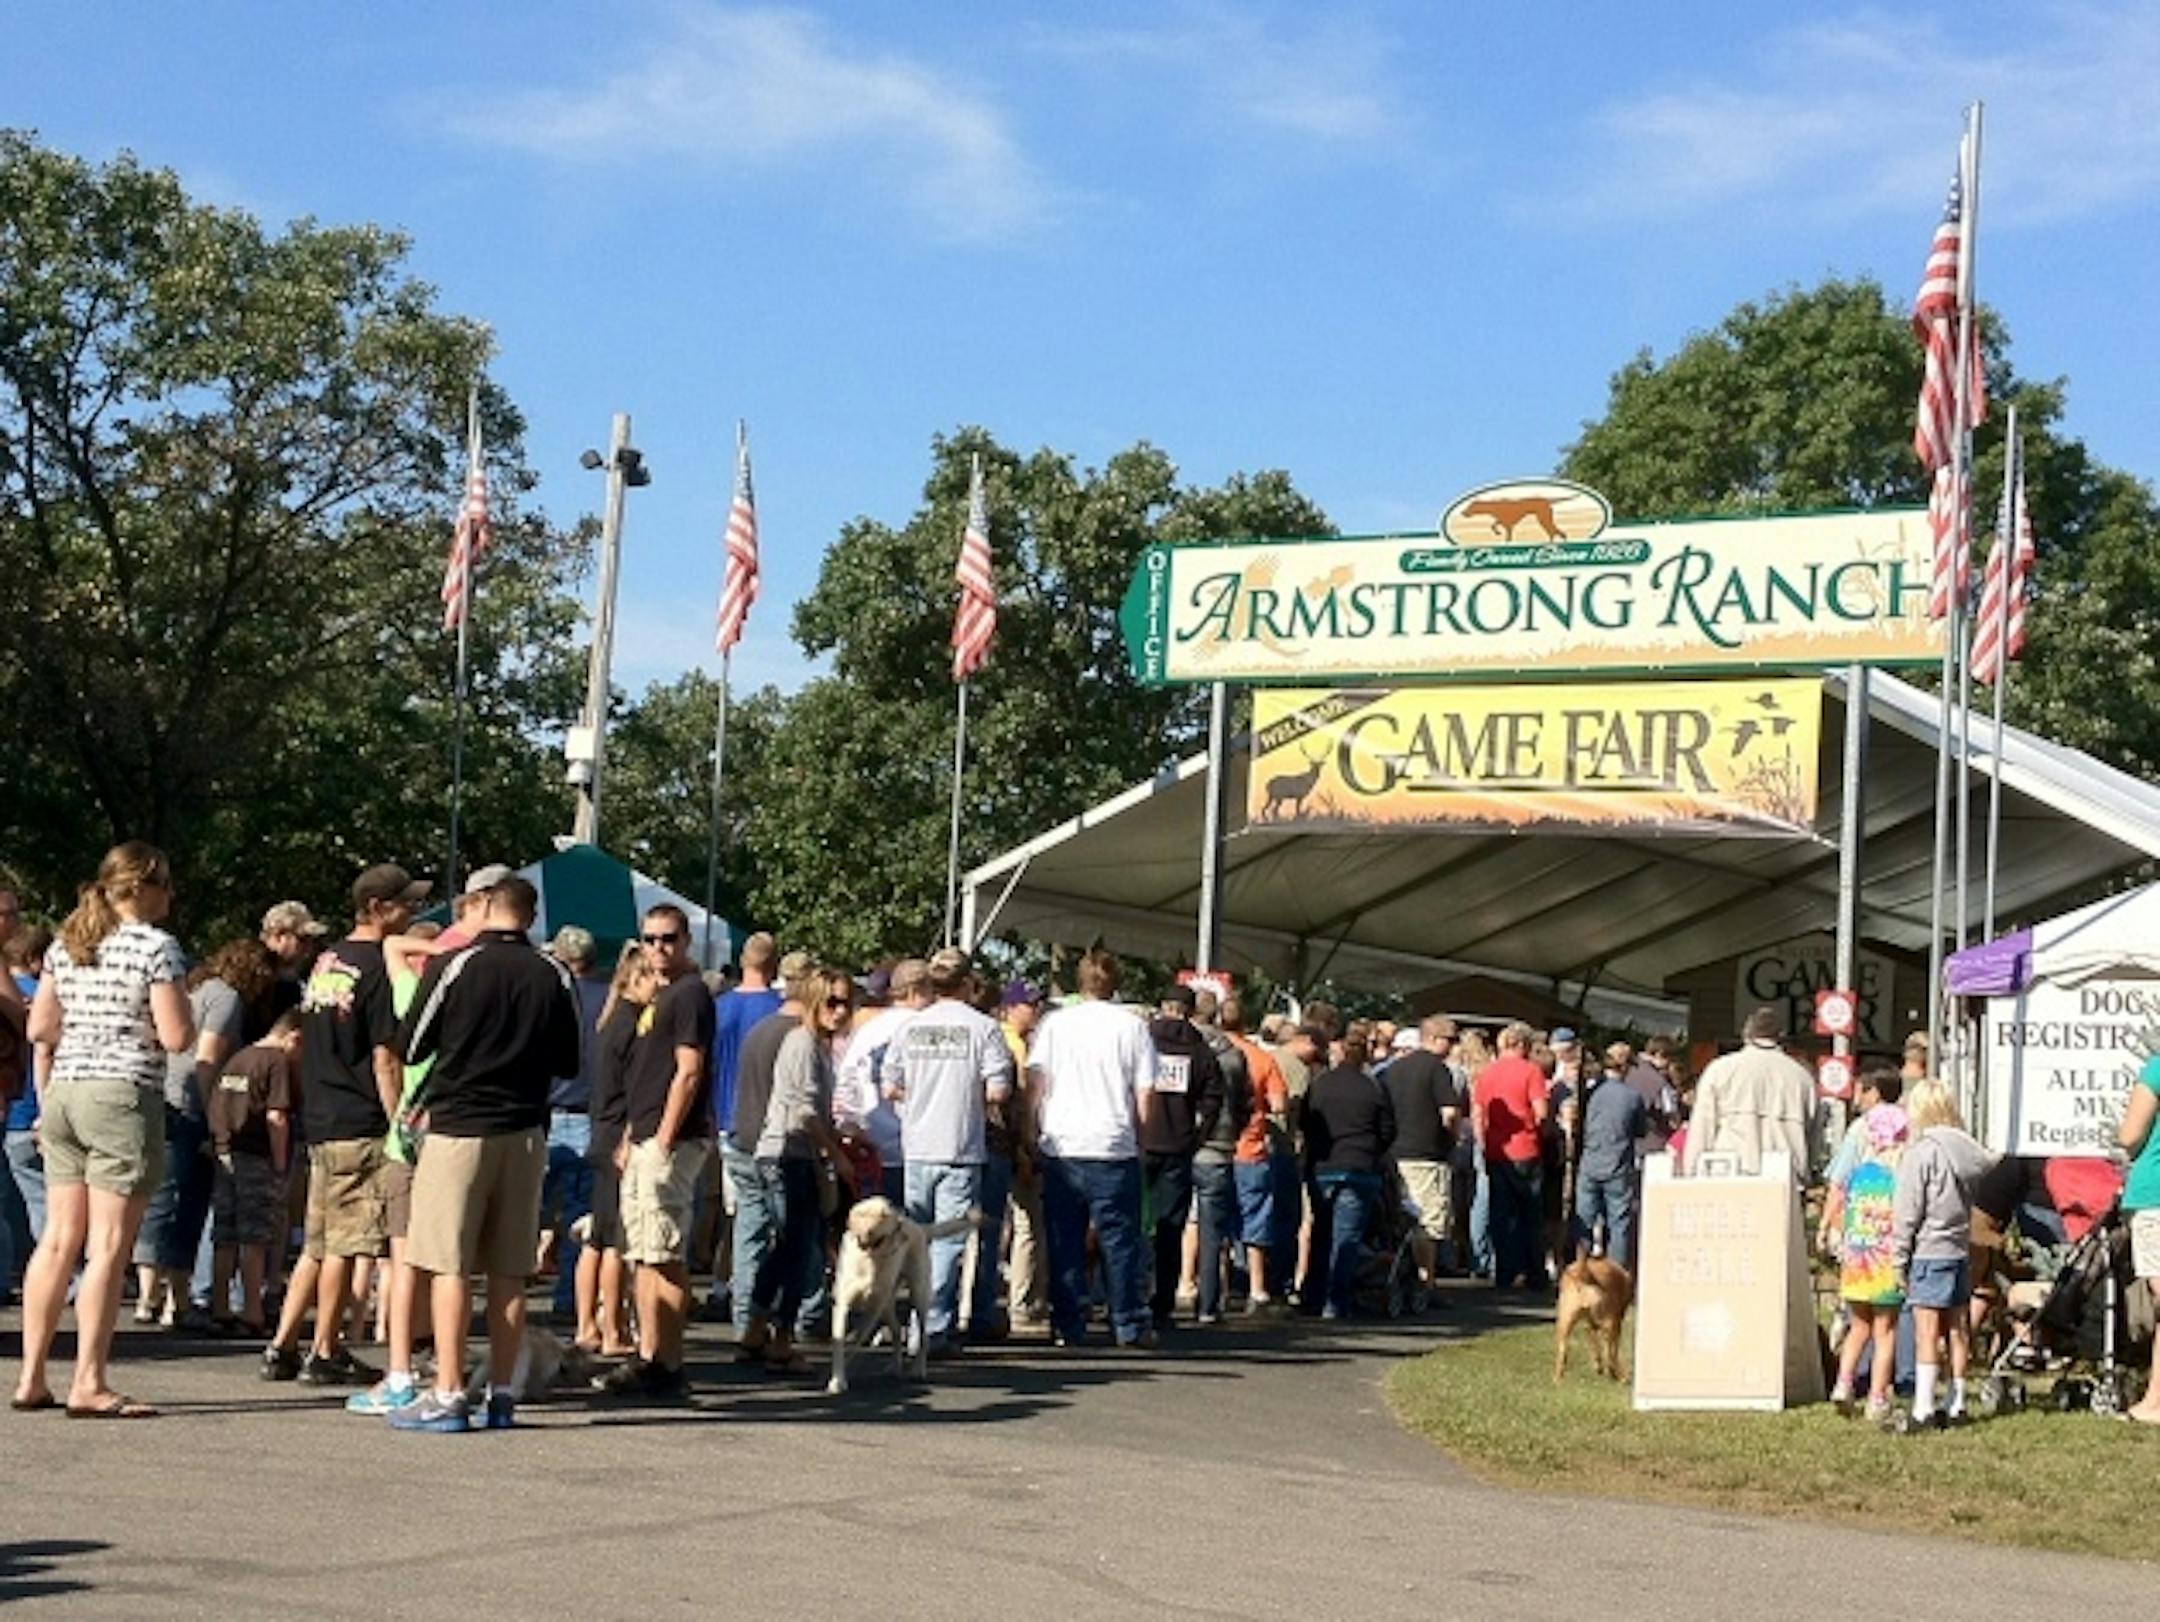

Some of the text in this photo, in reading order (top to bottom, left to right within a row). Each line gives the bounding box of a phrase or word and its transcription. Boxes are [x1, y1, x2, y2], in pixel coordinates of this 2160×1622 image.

[1407, 549, 1468, 572] Family
[1470, 547, 1534, 568] Owned
[1144, 550, 1167, 679] OFFICE
[1176, 571, 1635, 642] ARMSTRONG
[1337, 708, 1718, 796] GAME FAIR
[2046, 1069, 2105, 1091] ALL
